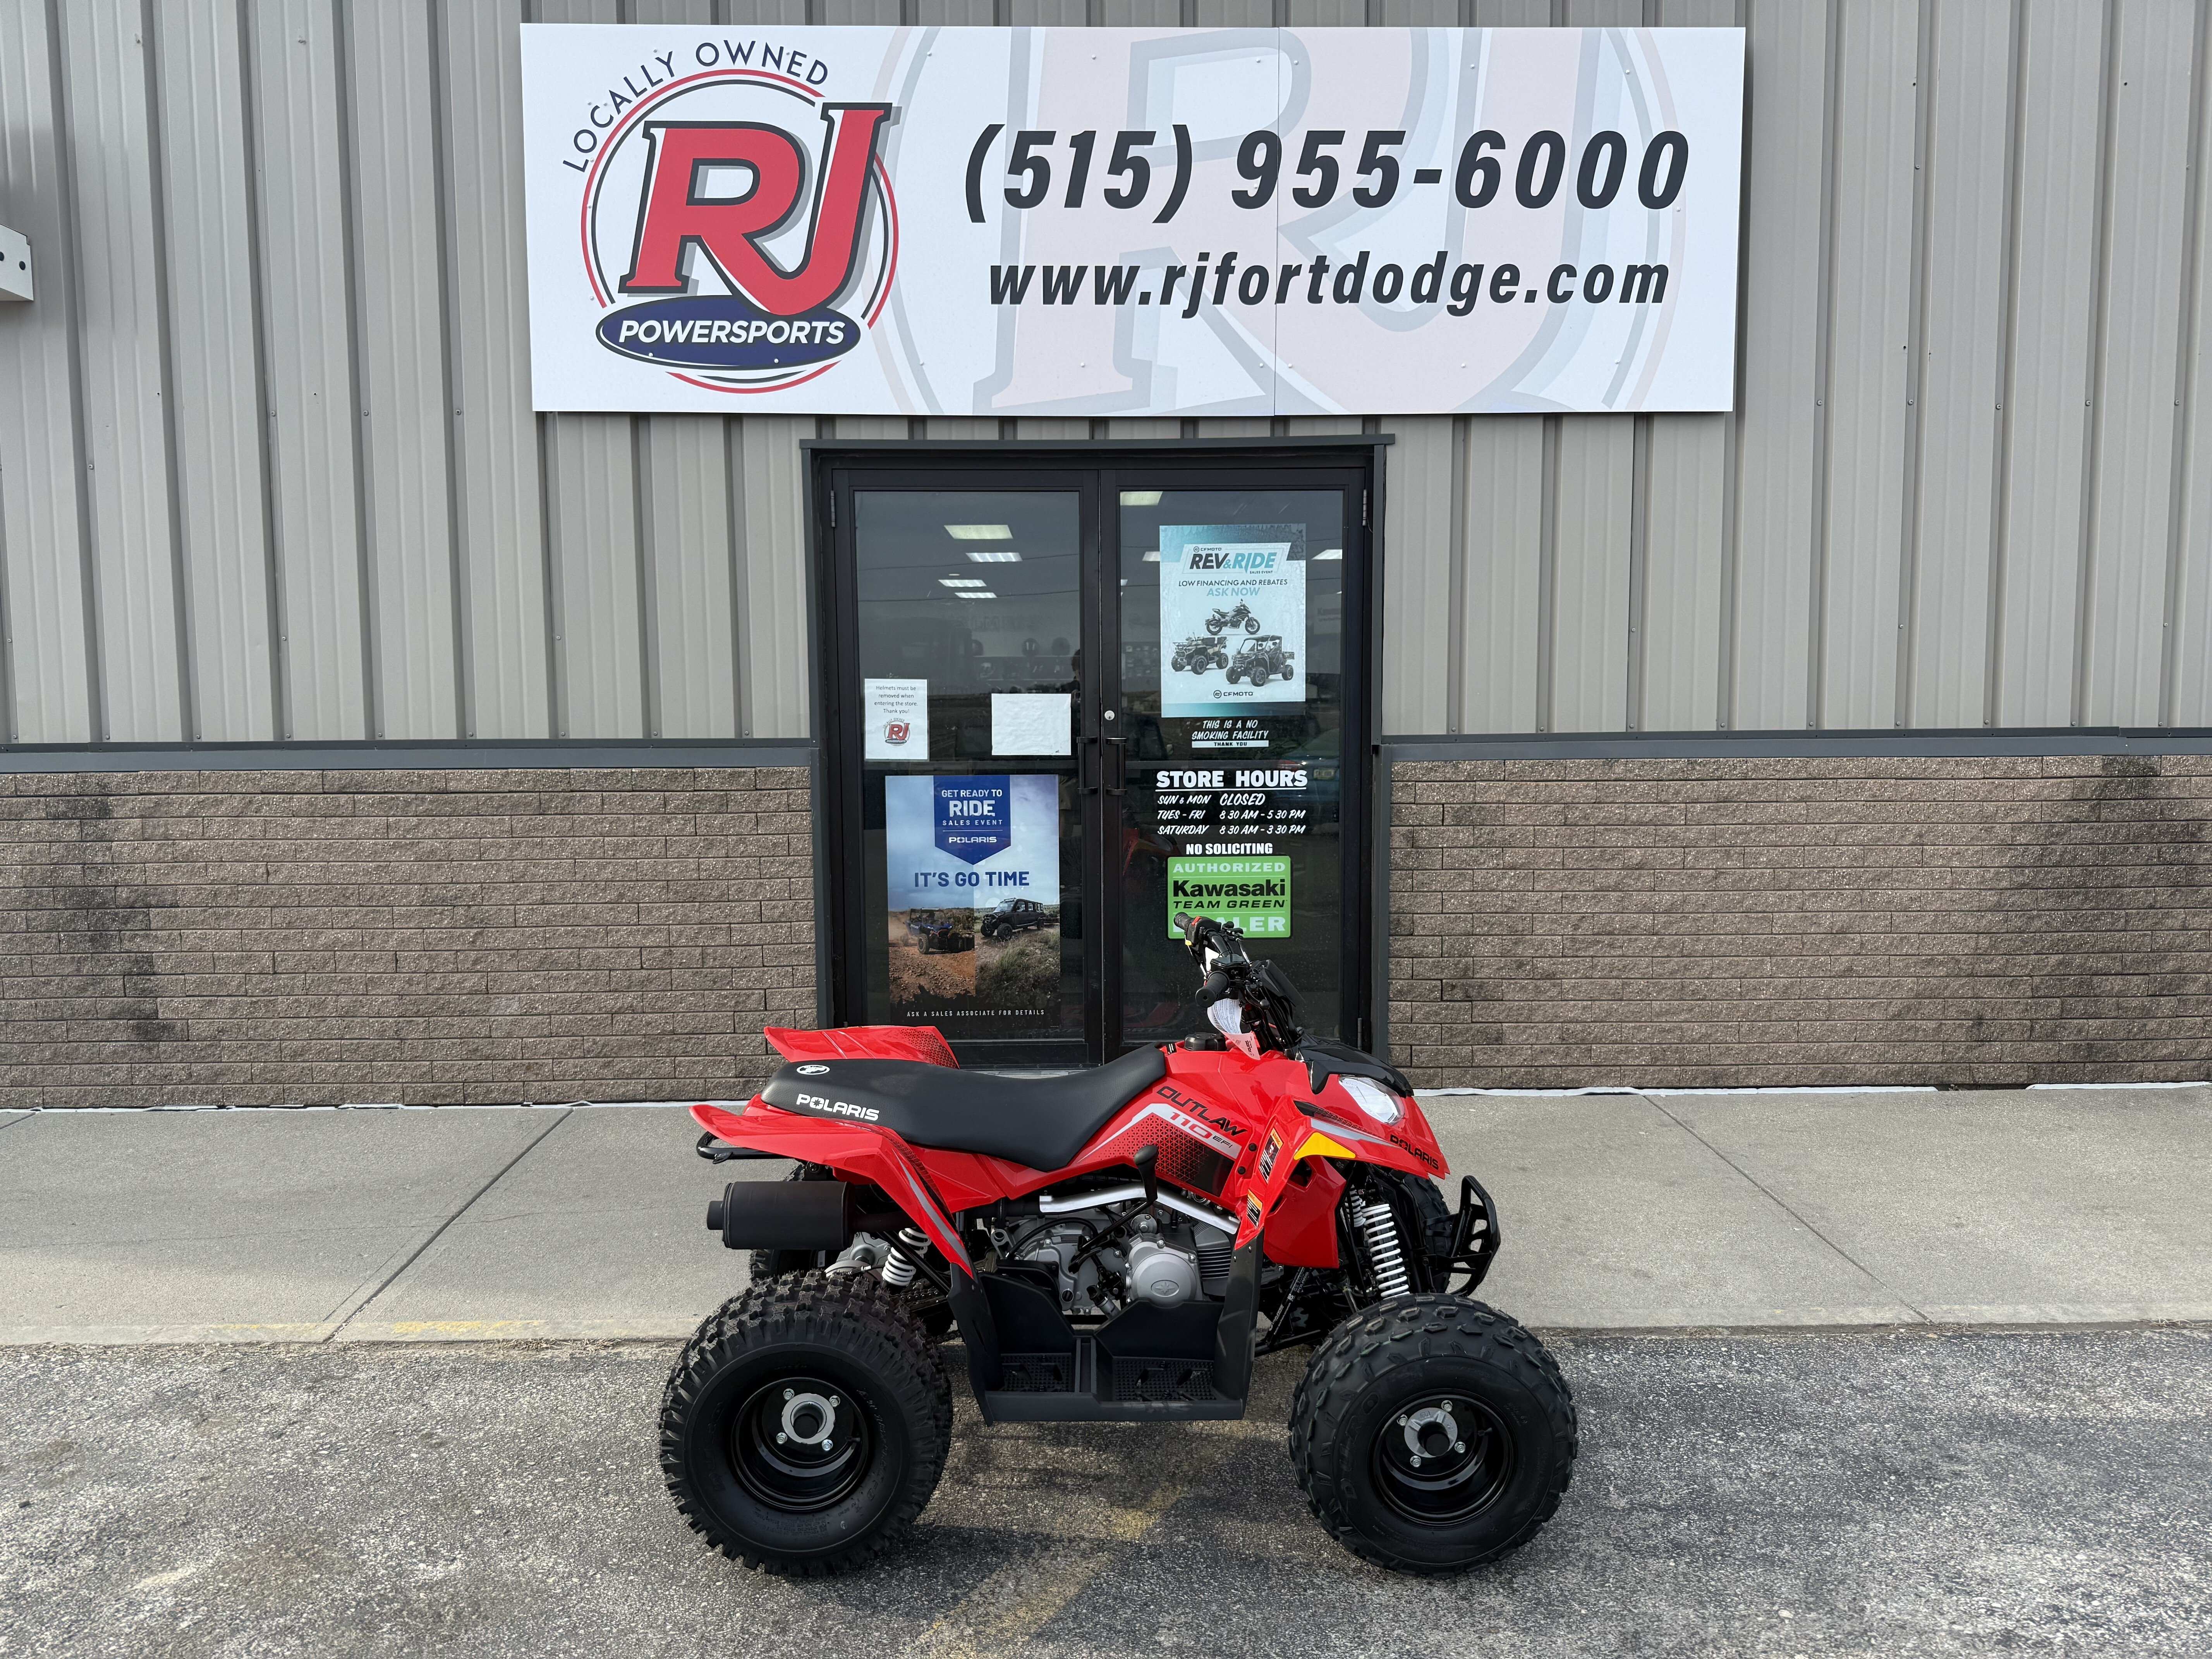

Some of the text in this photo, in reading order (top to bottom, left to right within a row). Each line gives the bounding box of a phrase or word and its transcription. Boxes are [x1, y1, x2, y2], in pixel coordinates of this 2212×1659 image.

[563, 40, 828, 172] LOCALLY OWNED
[966, 124, 1689, 223] (515) 955-6000
[618, 103, 892, 318] RJ
[990, 251, 1669, 319] www.rjfortdodge.com
[619, 320, 845, 344] POWERSPORTS
[1207, 587, 1260, 596] ASK NOW
[887, 723, 910, 740] RJ
[1203, 720, 1220, 728] THIS
[1246, 720, 1258, 728] NO
[1192, 730, 1269, 740] SMOKING FACILITY
[1156, 770, 1307, 787] STORE HOURS
[1158, 795, 1179, 805] SUN
[1187, 795, 1211, 804] MON
[1220, 793, 1265, 805] CLOSED
[950, 800, 995, 817] RIDE
[1158, 810, 1180, 820] TUES
[1189, 810, 1206, 819] FRI
[1219, 811, 1226, 819] 8
[1228, 811, 1240, 819] 30
[1241, 810, 1259, 819] AM
[1267, 810, 1274, 819] 5
[1275, 810, 1287, 819] 30
[1289, 810, 1306, 818] PM
[1158, 825, 1209, 835] SATURDAY
[1219, 826, 1226, 834] 8
[1228, 826, 1239, 834] 30
[1241, 825, 1259, 834] AM
[1267, 825, 1273, 834] 3
[1275, 825, 1287, 834] 30
[1289, 825, 1306, 833] PM
[1186, 843, 1273, 854] NO SOLICITING
[1173, 863, 1285, 872] AUTHORIZED
[955, 872, 979, 886] GO
[985, 872, 1029, 886] TIME
[1173, 879, 1285, 897] Kawasaki
[796, 1094, 879, 1121] POLARIS
[1156, 1086, 1248, 1136] OUTLAW
[1170, 1112, 1233, 1148] 110 EFI
[1390, 1134, 1439, 1170] POLARIS
